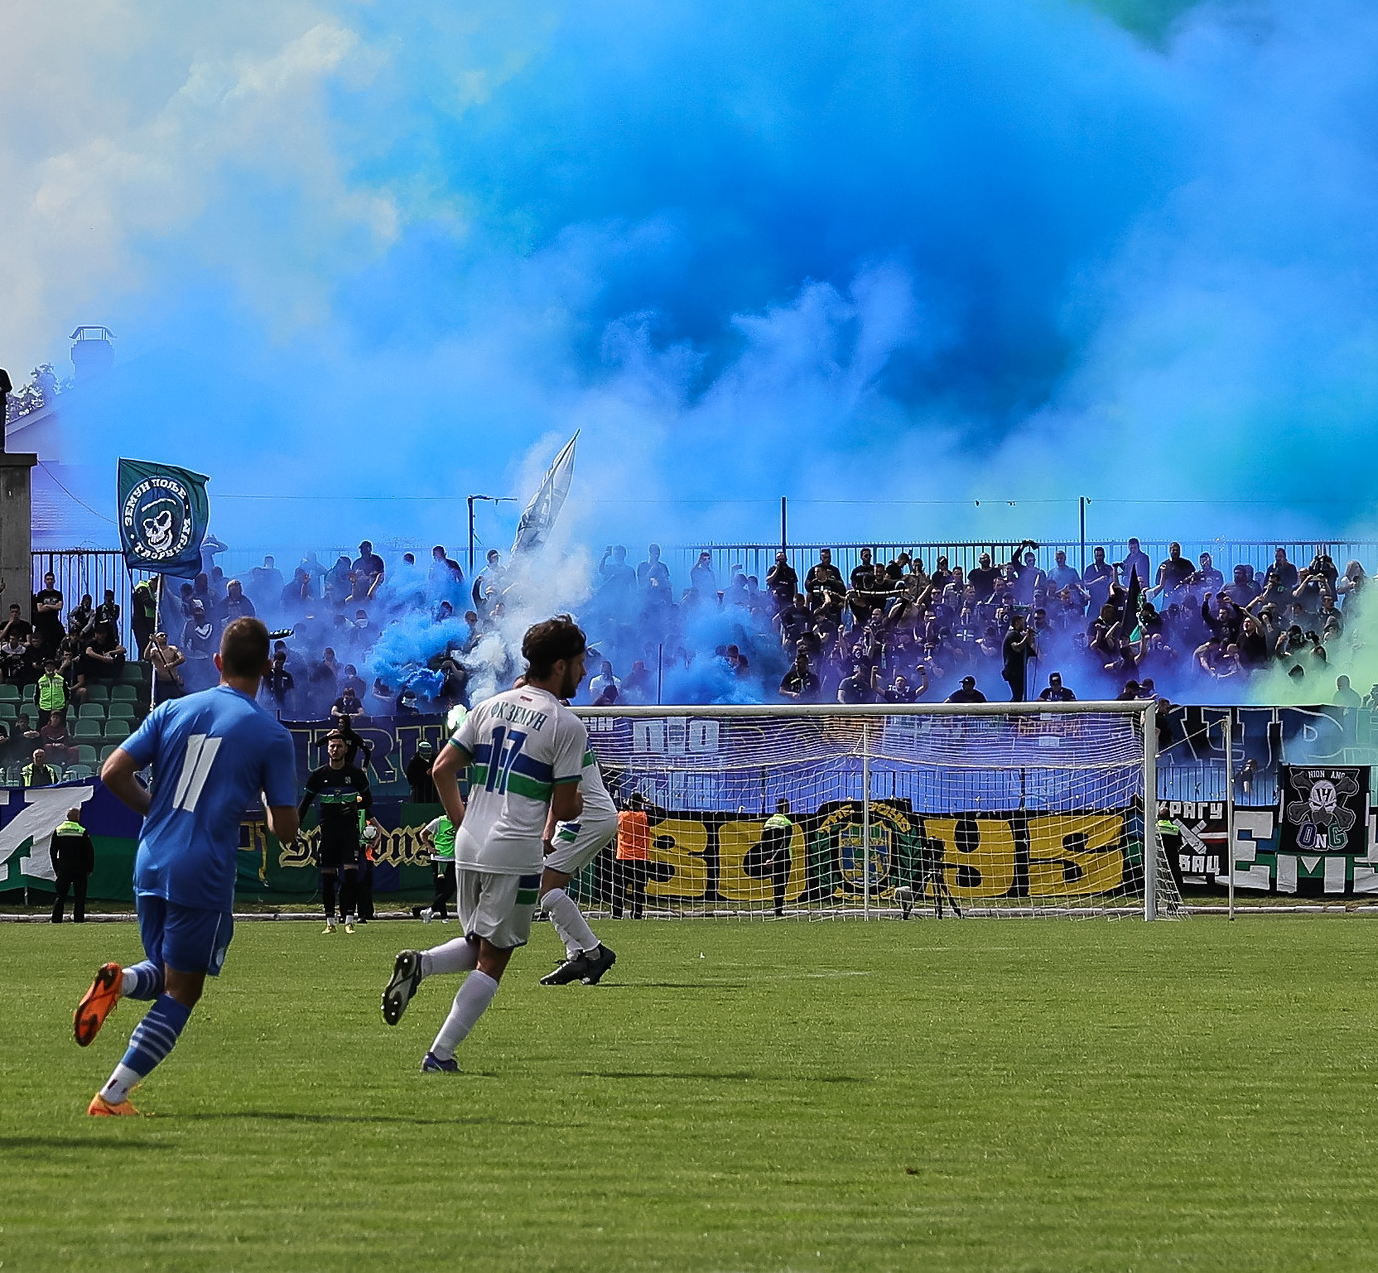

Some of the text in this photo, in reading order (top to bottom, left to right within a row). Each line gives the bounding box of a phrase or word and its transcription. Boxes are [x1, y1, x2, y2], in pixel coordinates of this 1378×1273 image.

[124, 478, 188, 527] ЗЕМУН ПОЉЕ
[490, 701, 549, 732] ФК ЗЕМУН
[172, 733, 222, 813] 11
[485, 725, 528, 795] 17
[1296, 821, 1349, 850] ONG
